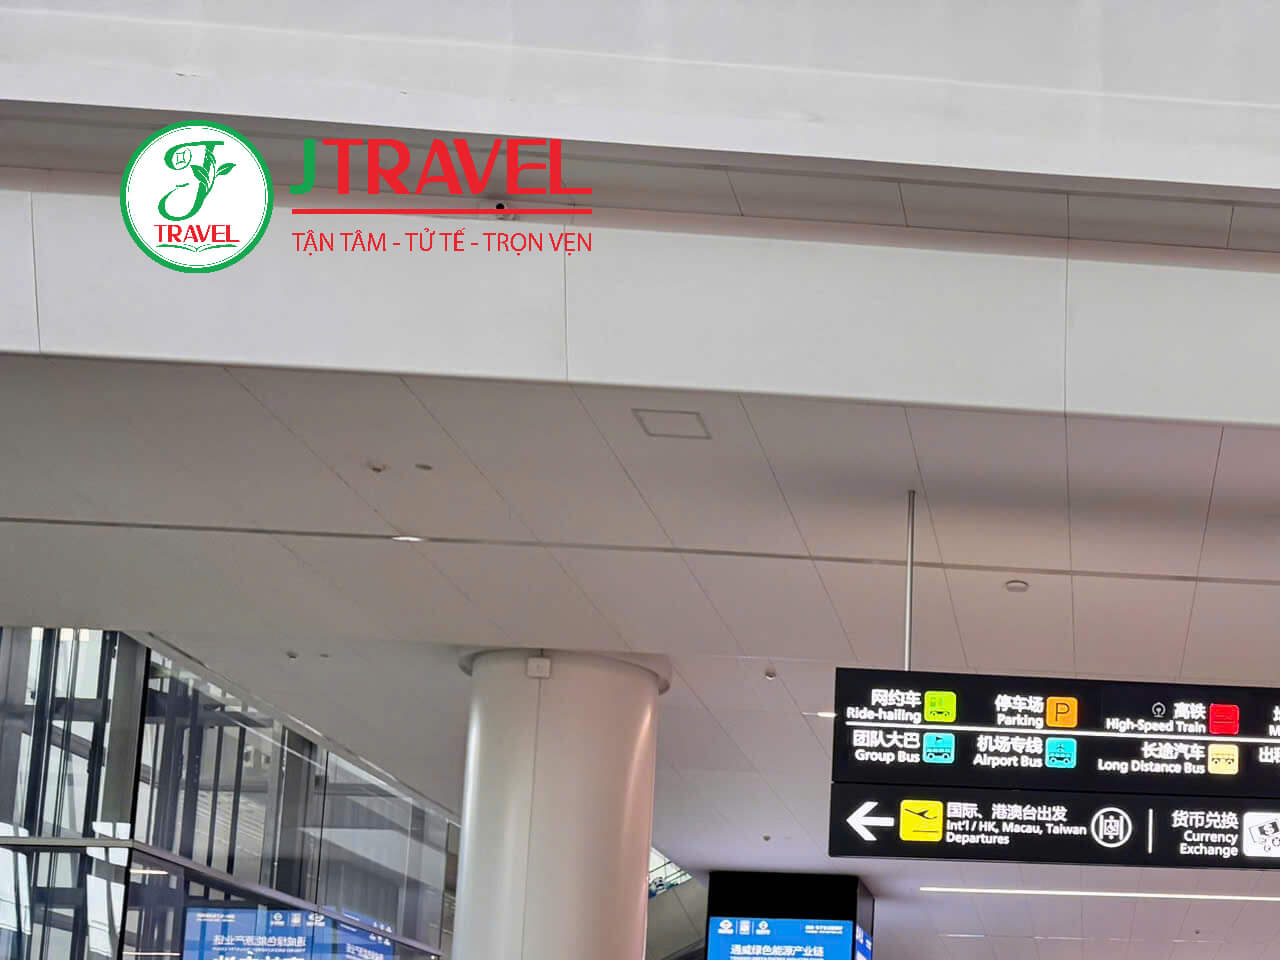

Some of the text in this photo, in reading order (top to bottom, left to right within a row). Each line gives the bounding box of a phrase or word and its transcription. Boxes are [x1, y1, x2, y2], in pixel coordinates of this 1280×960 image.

[871, 689, 922, 708] 网约车
[995, 694, 1044, 713] 停车场
[846, 707, 922, 724] Ride-hailing
[997, 714, 1044, 729] Parking
[1106, 718, 1206, 734] High-Speed Train
[852, 730, 920, 748] 团队大巴
[977, 735, 1043, 753] 机场专线
[855, 749, 920, 764] Group Bus
[1141, 742, 1205, 760] 长途汽车
[972, 752, 1043, 769] Airport Bus
[1097, 758, 1206, 774] Long Distance Bus
[1171, 810, 1240, 830] 货币兑换
[1046, 823, 1087, 836] Taiwan
[1183, 830, 1238, 844] Currency
[945, 831, 1010, 845] Departures
[1179, 843, 1239, 858] Exchange
